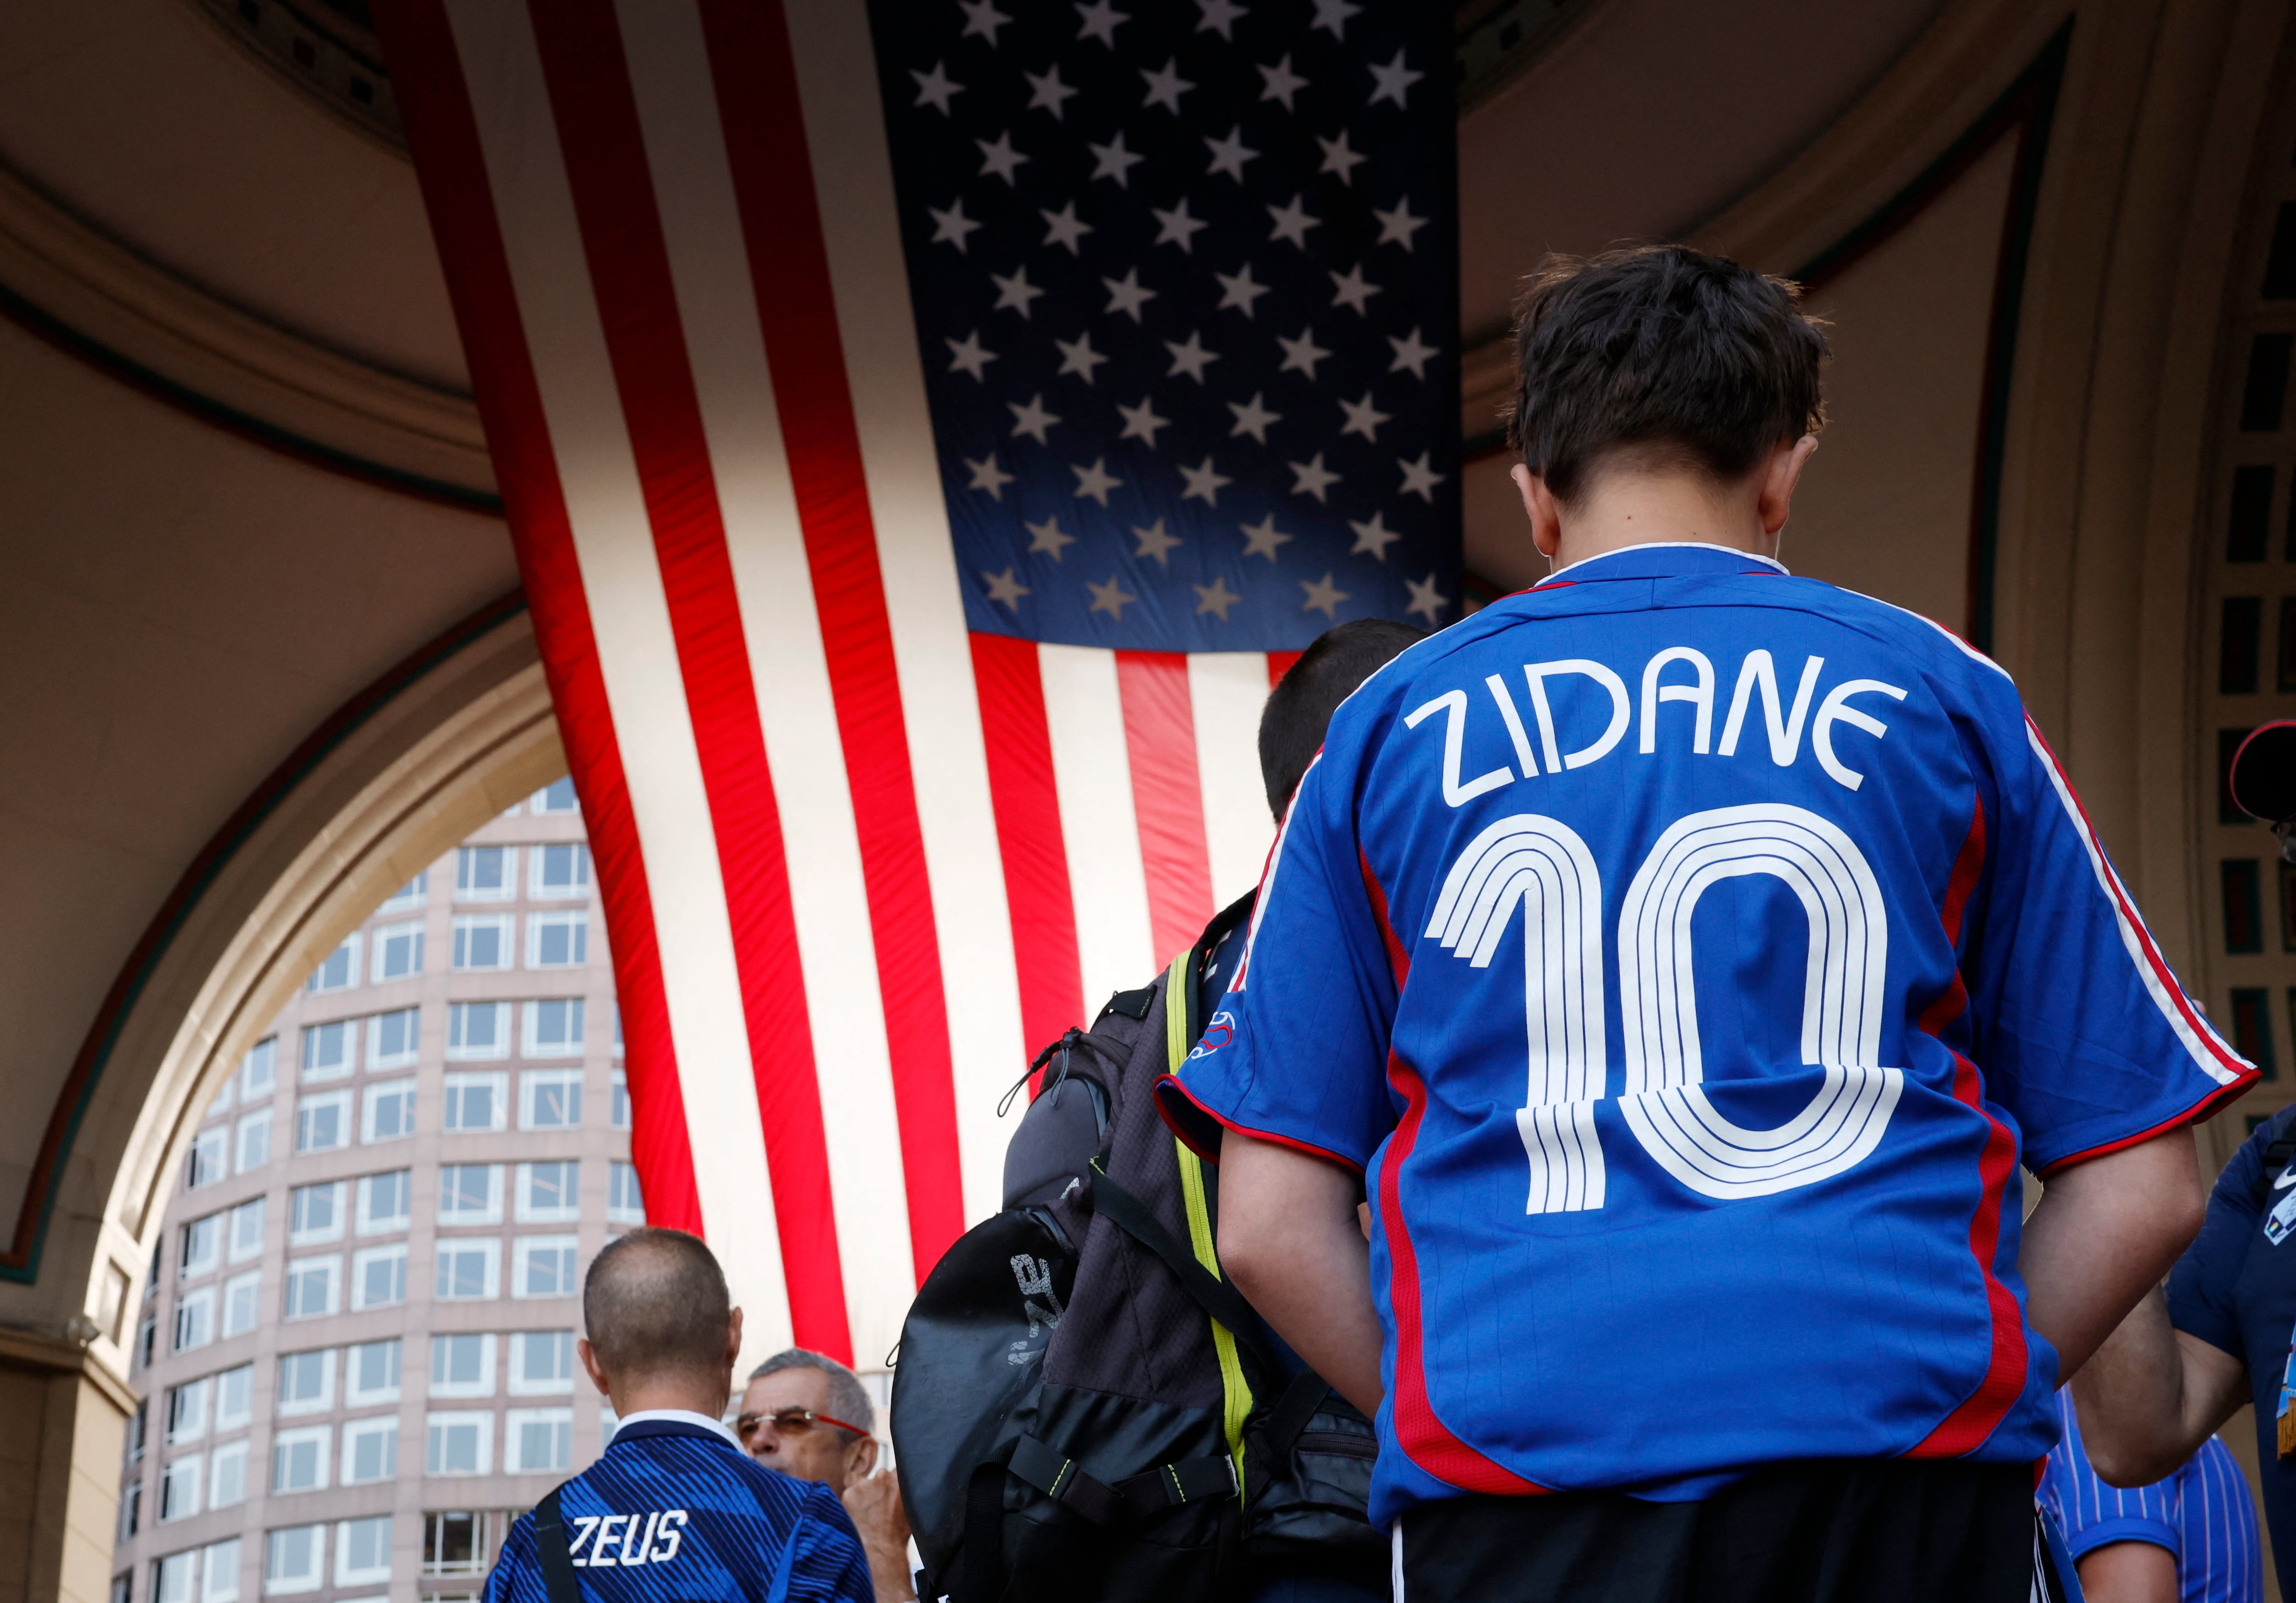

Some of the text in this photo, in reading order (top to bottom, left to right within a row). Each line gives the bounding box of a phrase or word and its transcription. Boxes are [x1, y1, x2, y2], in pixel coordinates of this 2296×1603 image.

[1403, 646, 1908, 807] ZIDANE
[1424, 803, 1904, 1215] 10
[569, 1509, 689, 1567] ZEUS
